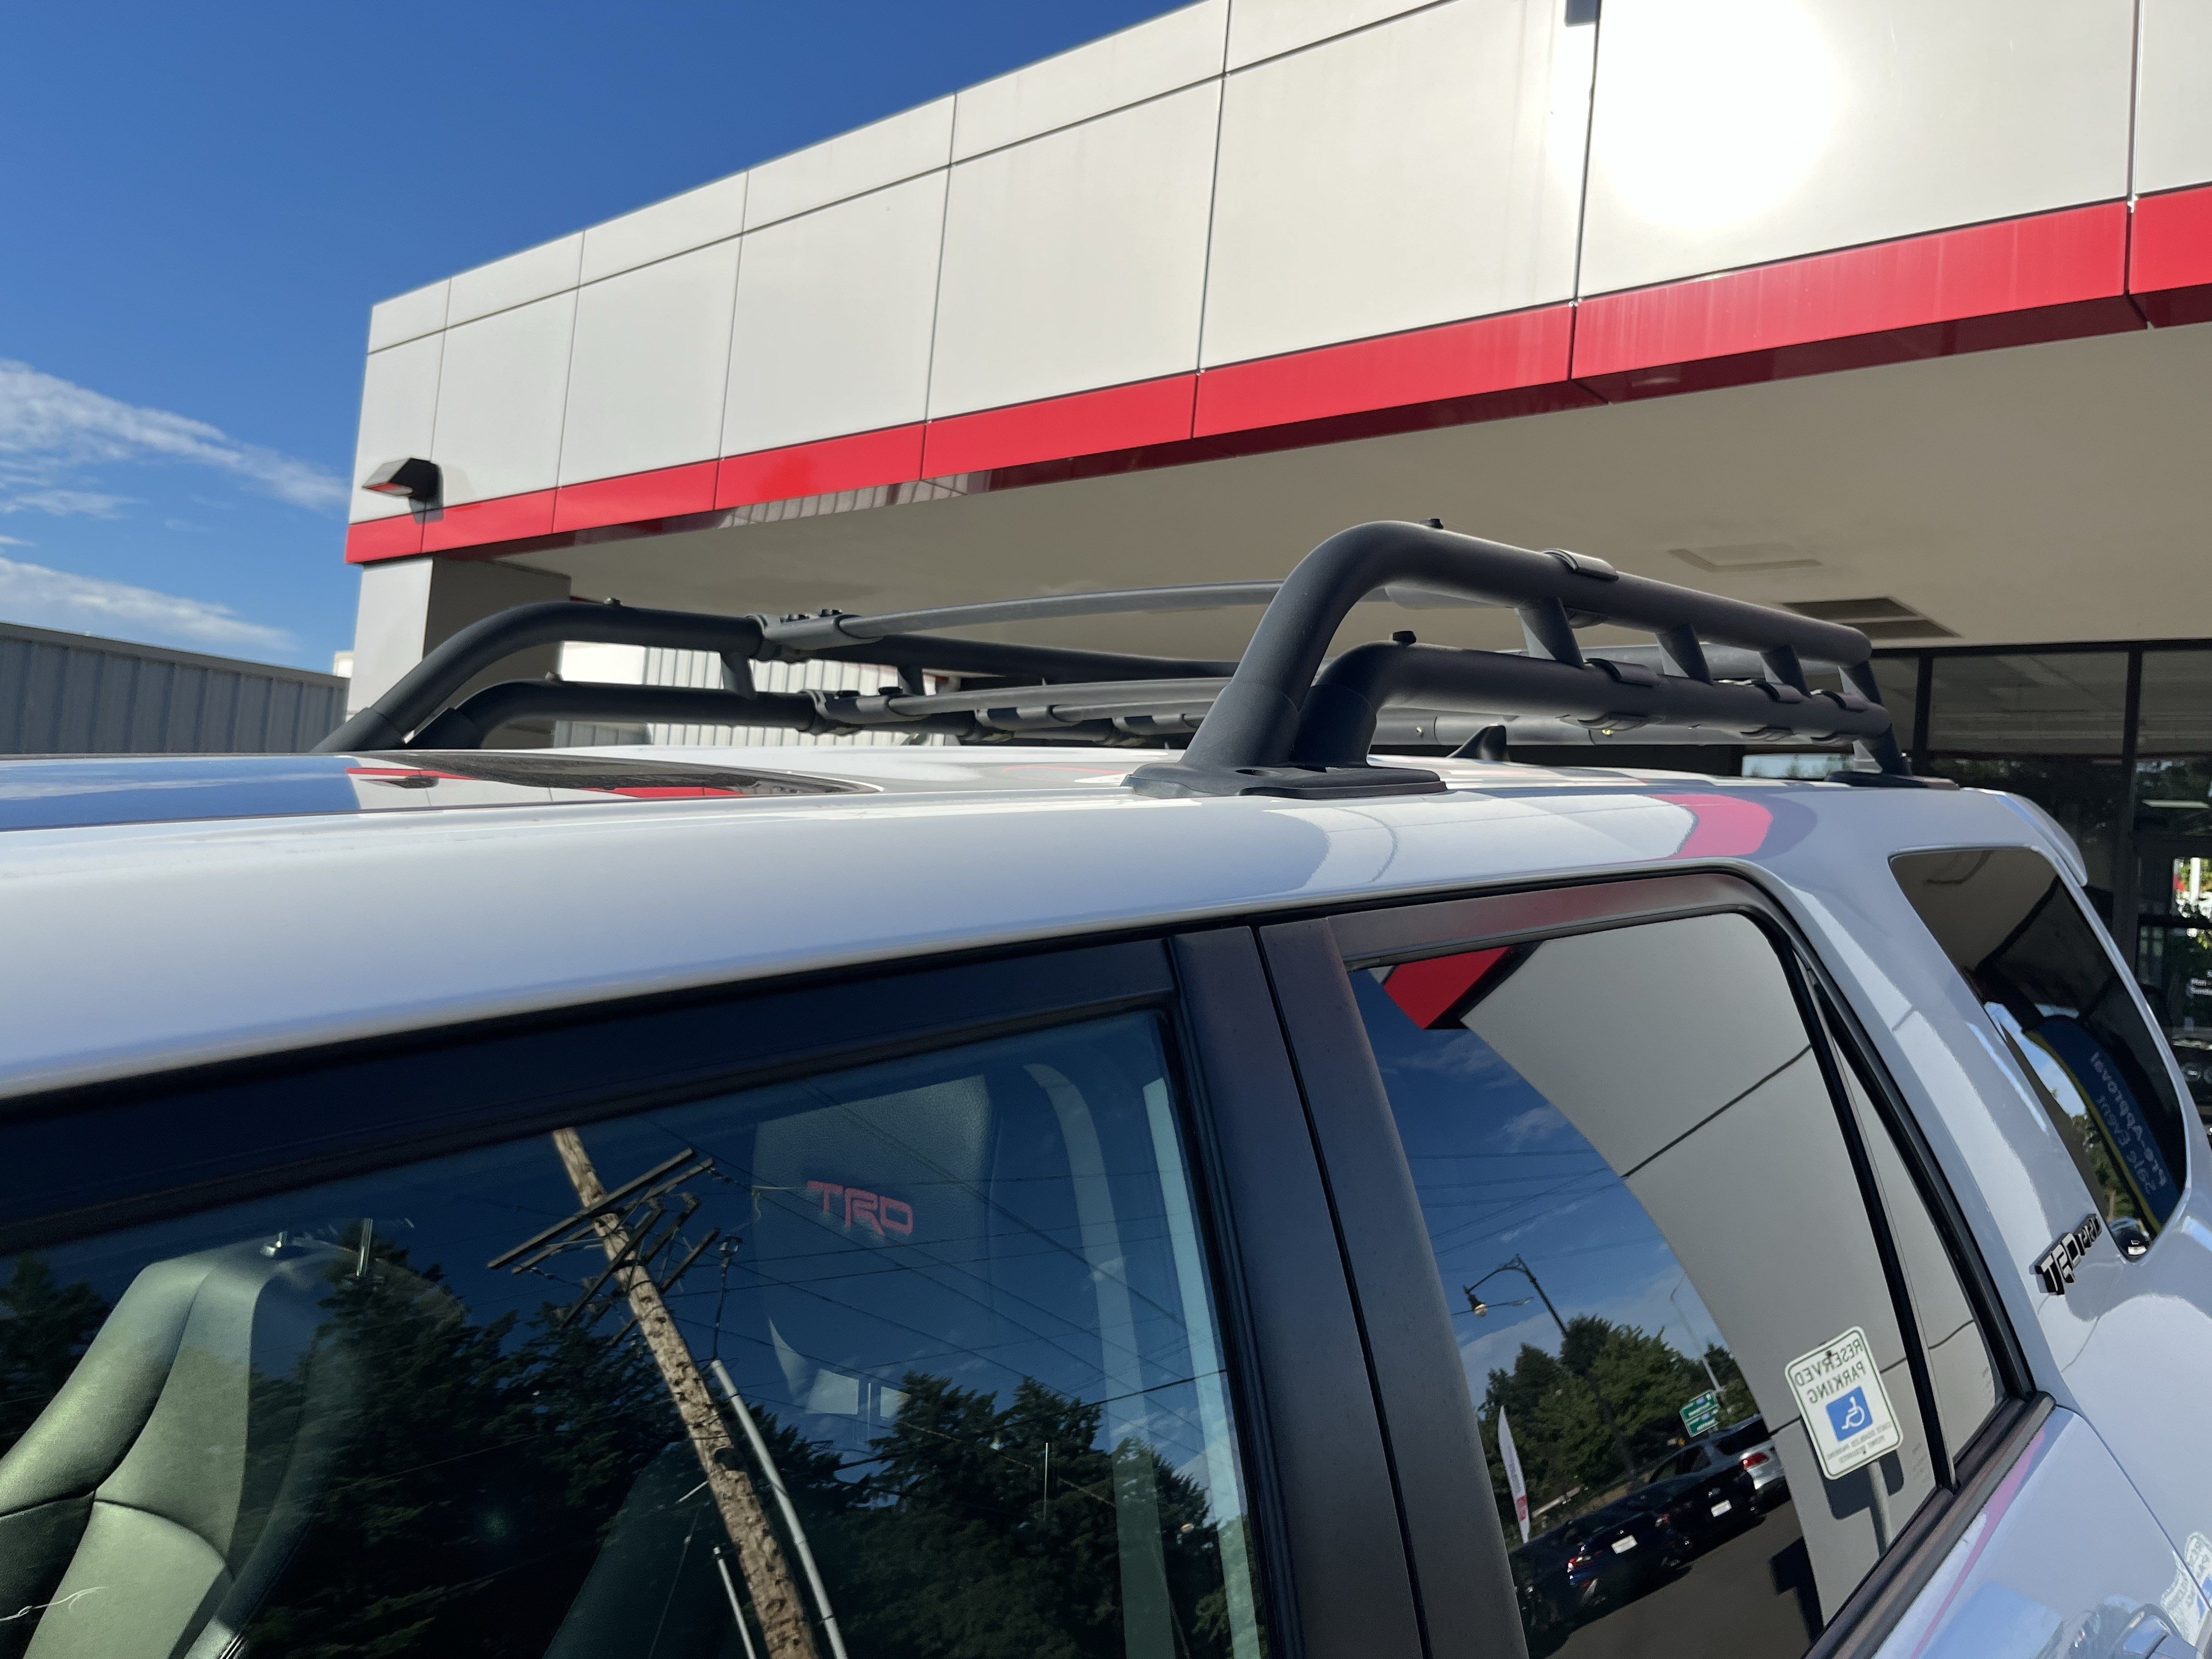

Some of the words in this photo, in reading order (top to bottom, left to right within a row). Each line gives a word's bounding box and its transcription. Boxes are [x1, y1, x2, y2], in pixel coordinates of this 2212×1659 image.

[807, 1180, 913, 1235] TRD
[2035, 1232, 2081, 1295] TRD
[2076, 1214, 2102, 1256] PRO
